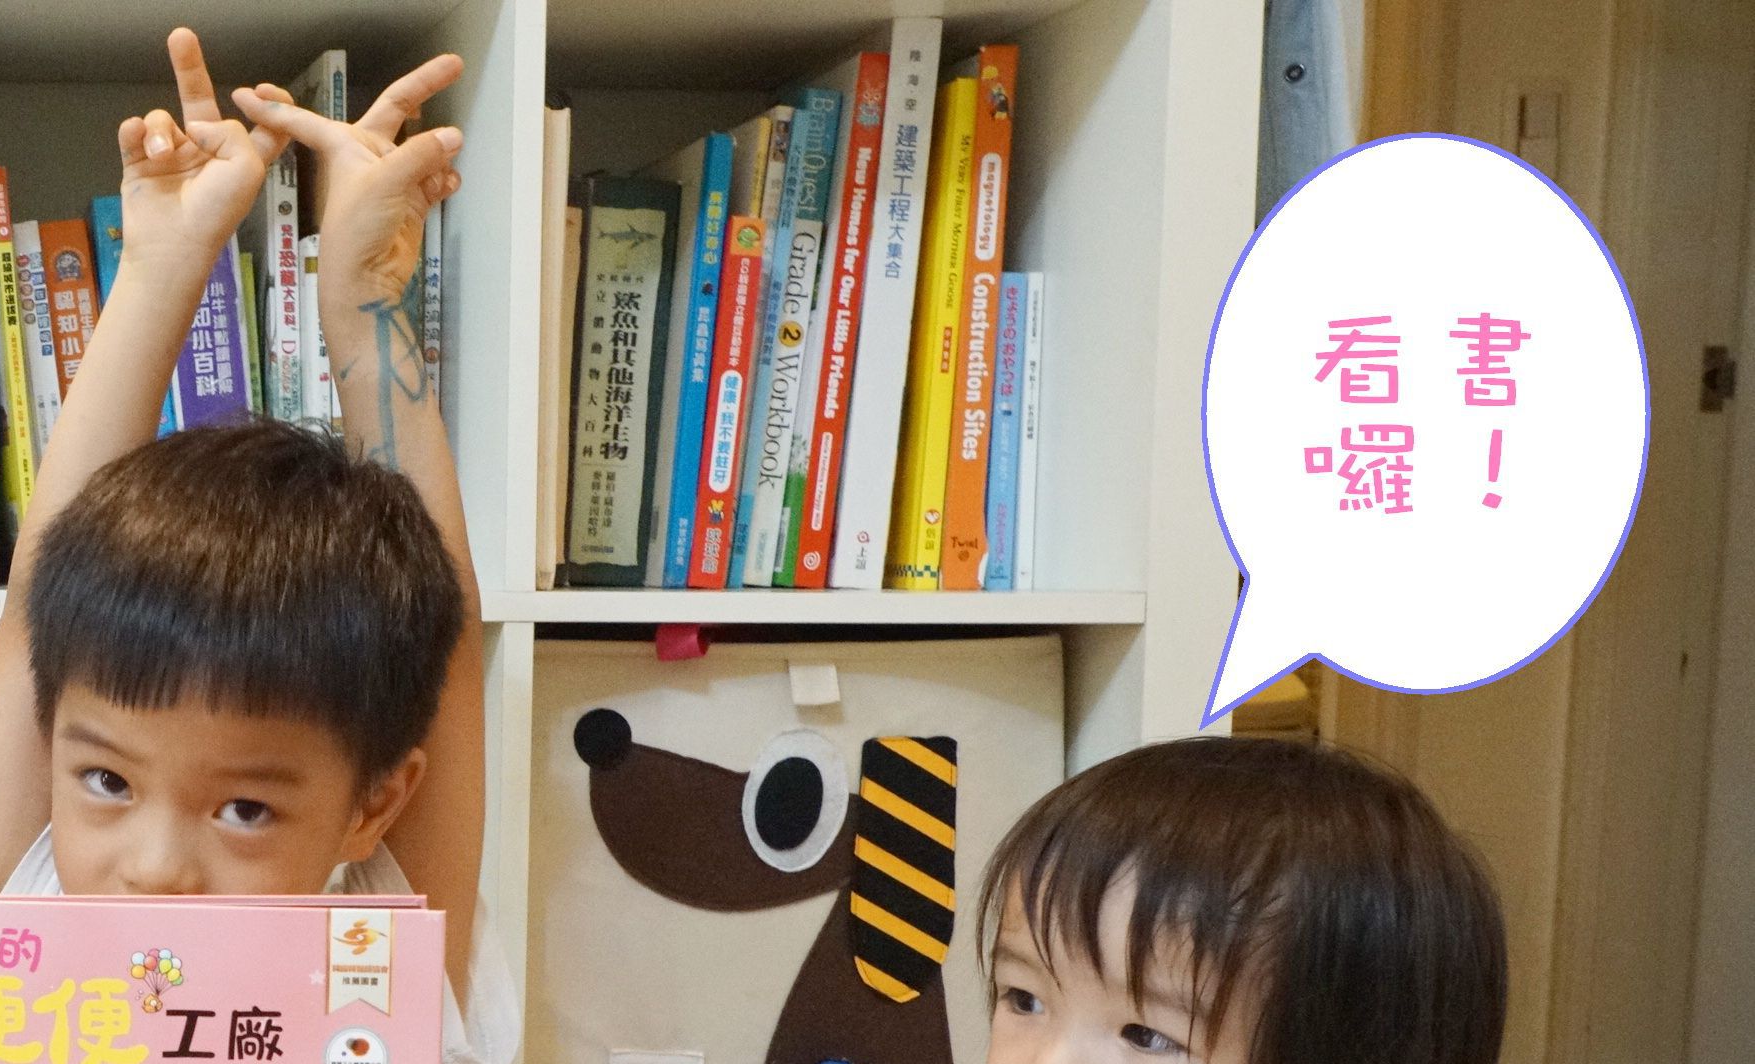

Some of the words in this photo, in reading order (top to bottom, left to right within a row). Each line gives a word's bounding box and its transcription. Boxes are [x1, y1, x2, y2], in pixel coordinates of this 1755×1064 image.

[854, 147, 872, 186] New
[845, 188, 866, 245] Homes
[884, 124, 920, 280] 建築工程大集合
[978, 161, 996, 251] magnetology
[783, 232, 817, 315] Grade
[838, 276, 856, 307] Our
[843, 247, 860, 275] for
[53, 289, 82, 382] 認知小百
[832, 308, 852, 353] Little
[965, 271, 996, 403] Construction
[582, 290, 606, 458] 立體動物大百科
[599, 292, 642, 461] 鯊魚和其他海洋生物
[824, 354, 845, 420] Friends
[757, 352, 801, 490] Workbook
[961, 408, 986, 461] Sites
[949, 536, 979, 549] Twirl
[162, 1005, 285, 1061] 工廠
